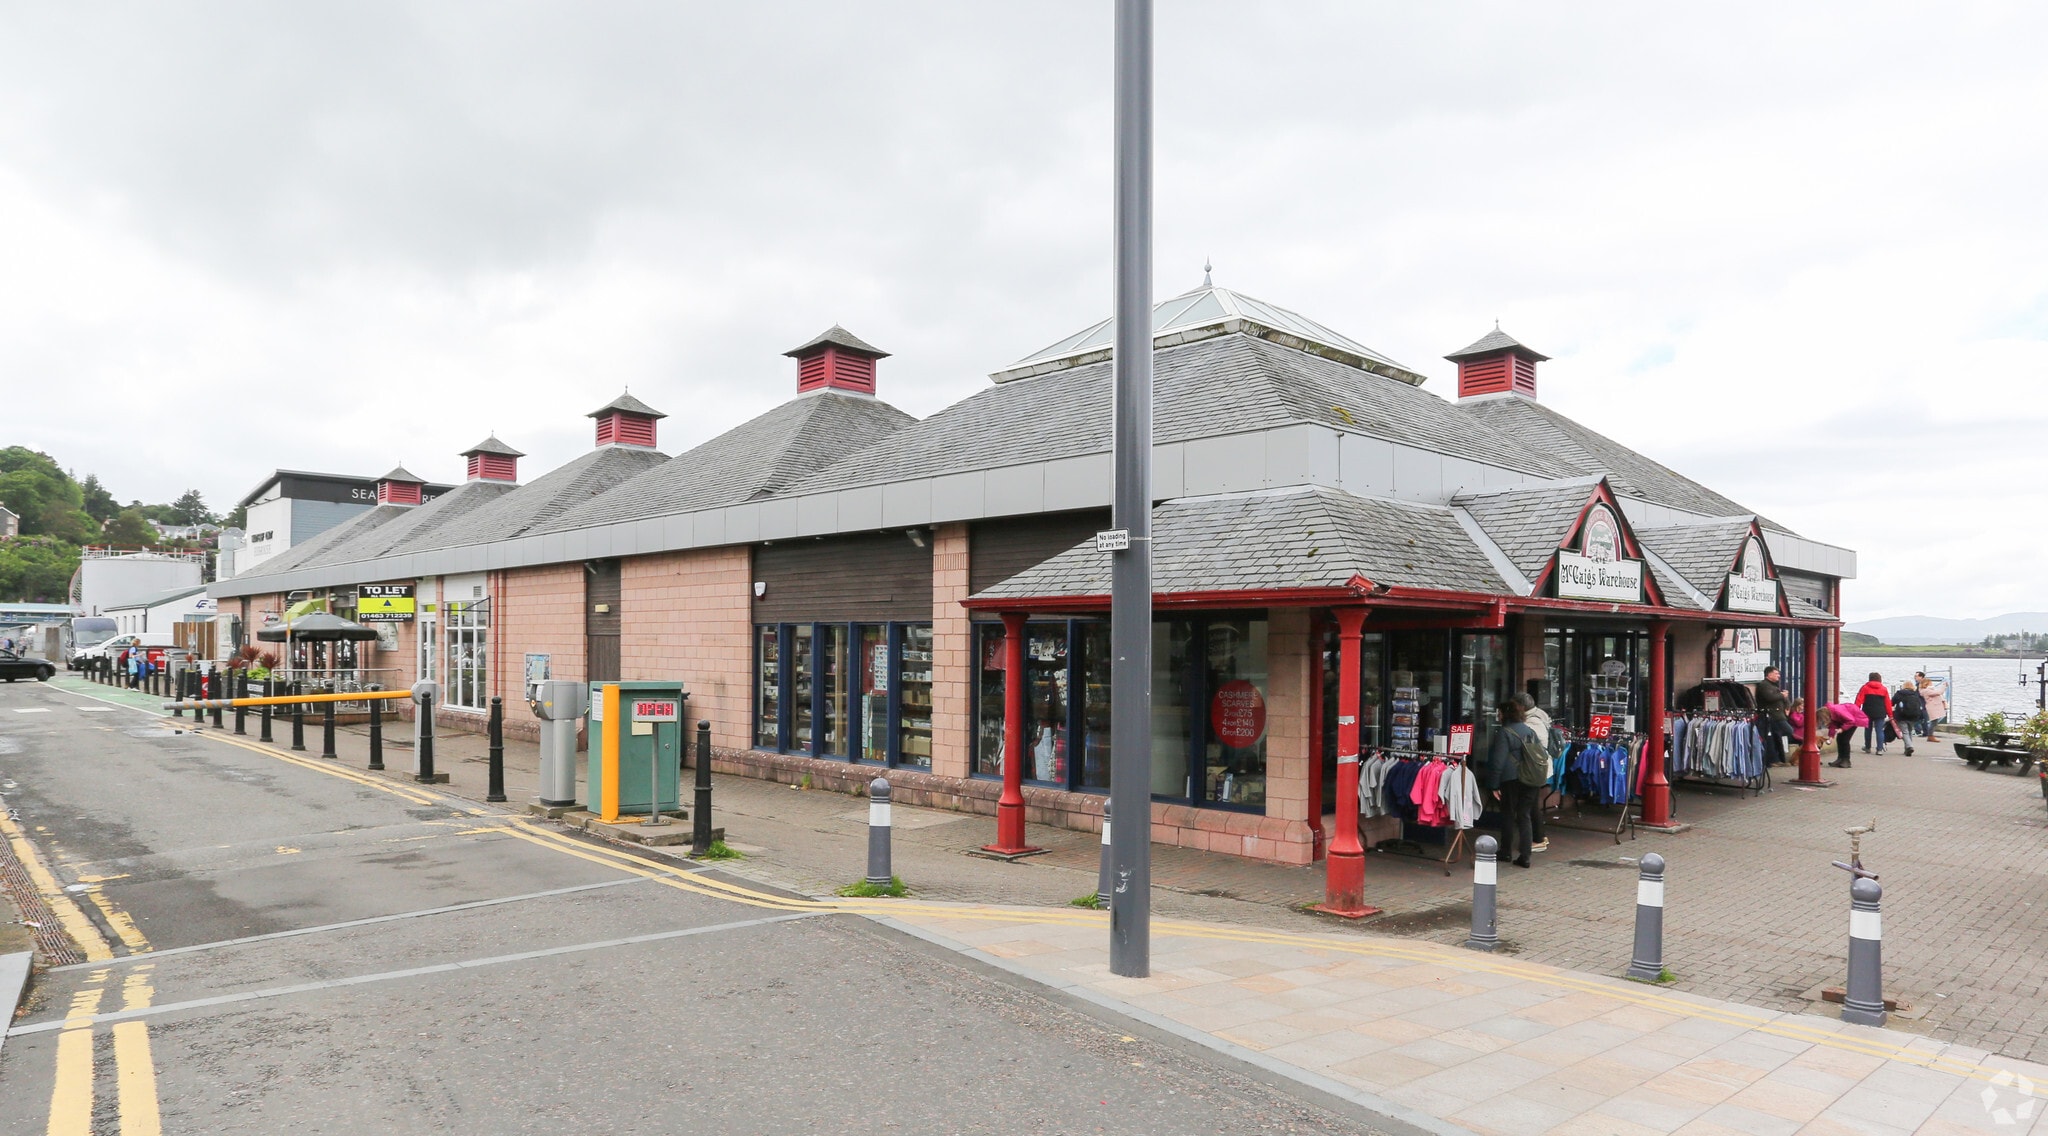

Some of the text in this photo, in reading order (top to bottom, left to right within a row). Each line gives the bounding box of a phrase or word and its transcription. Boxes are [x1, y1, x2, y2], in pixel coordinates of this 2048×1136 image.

[1598, 567, 1638, 589] Warehouse
[364, 586, 407, 595] TO LET
[1751, 586, 1775, 604] Warehouse
[1219, 691, 1258, 699] CASHMERE
[1222, 699, 1255, 708] SCARVES
[637, 702, 674, 716] OPEN
[1593, 717, 1601, 725] 2
[1451, 725, 1473, 734] SALE
[1590, 725, 1609, 737] £15
